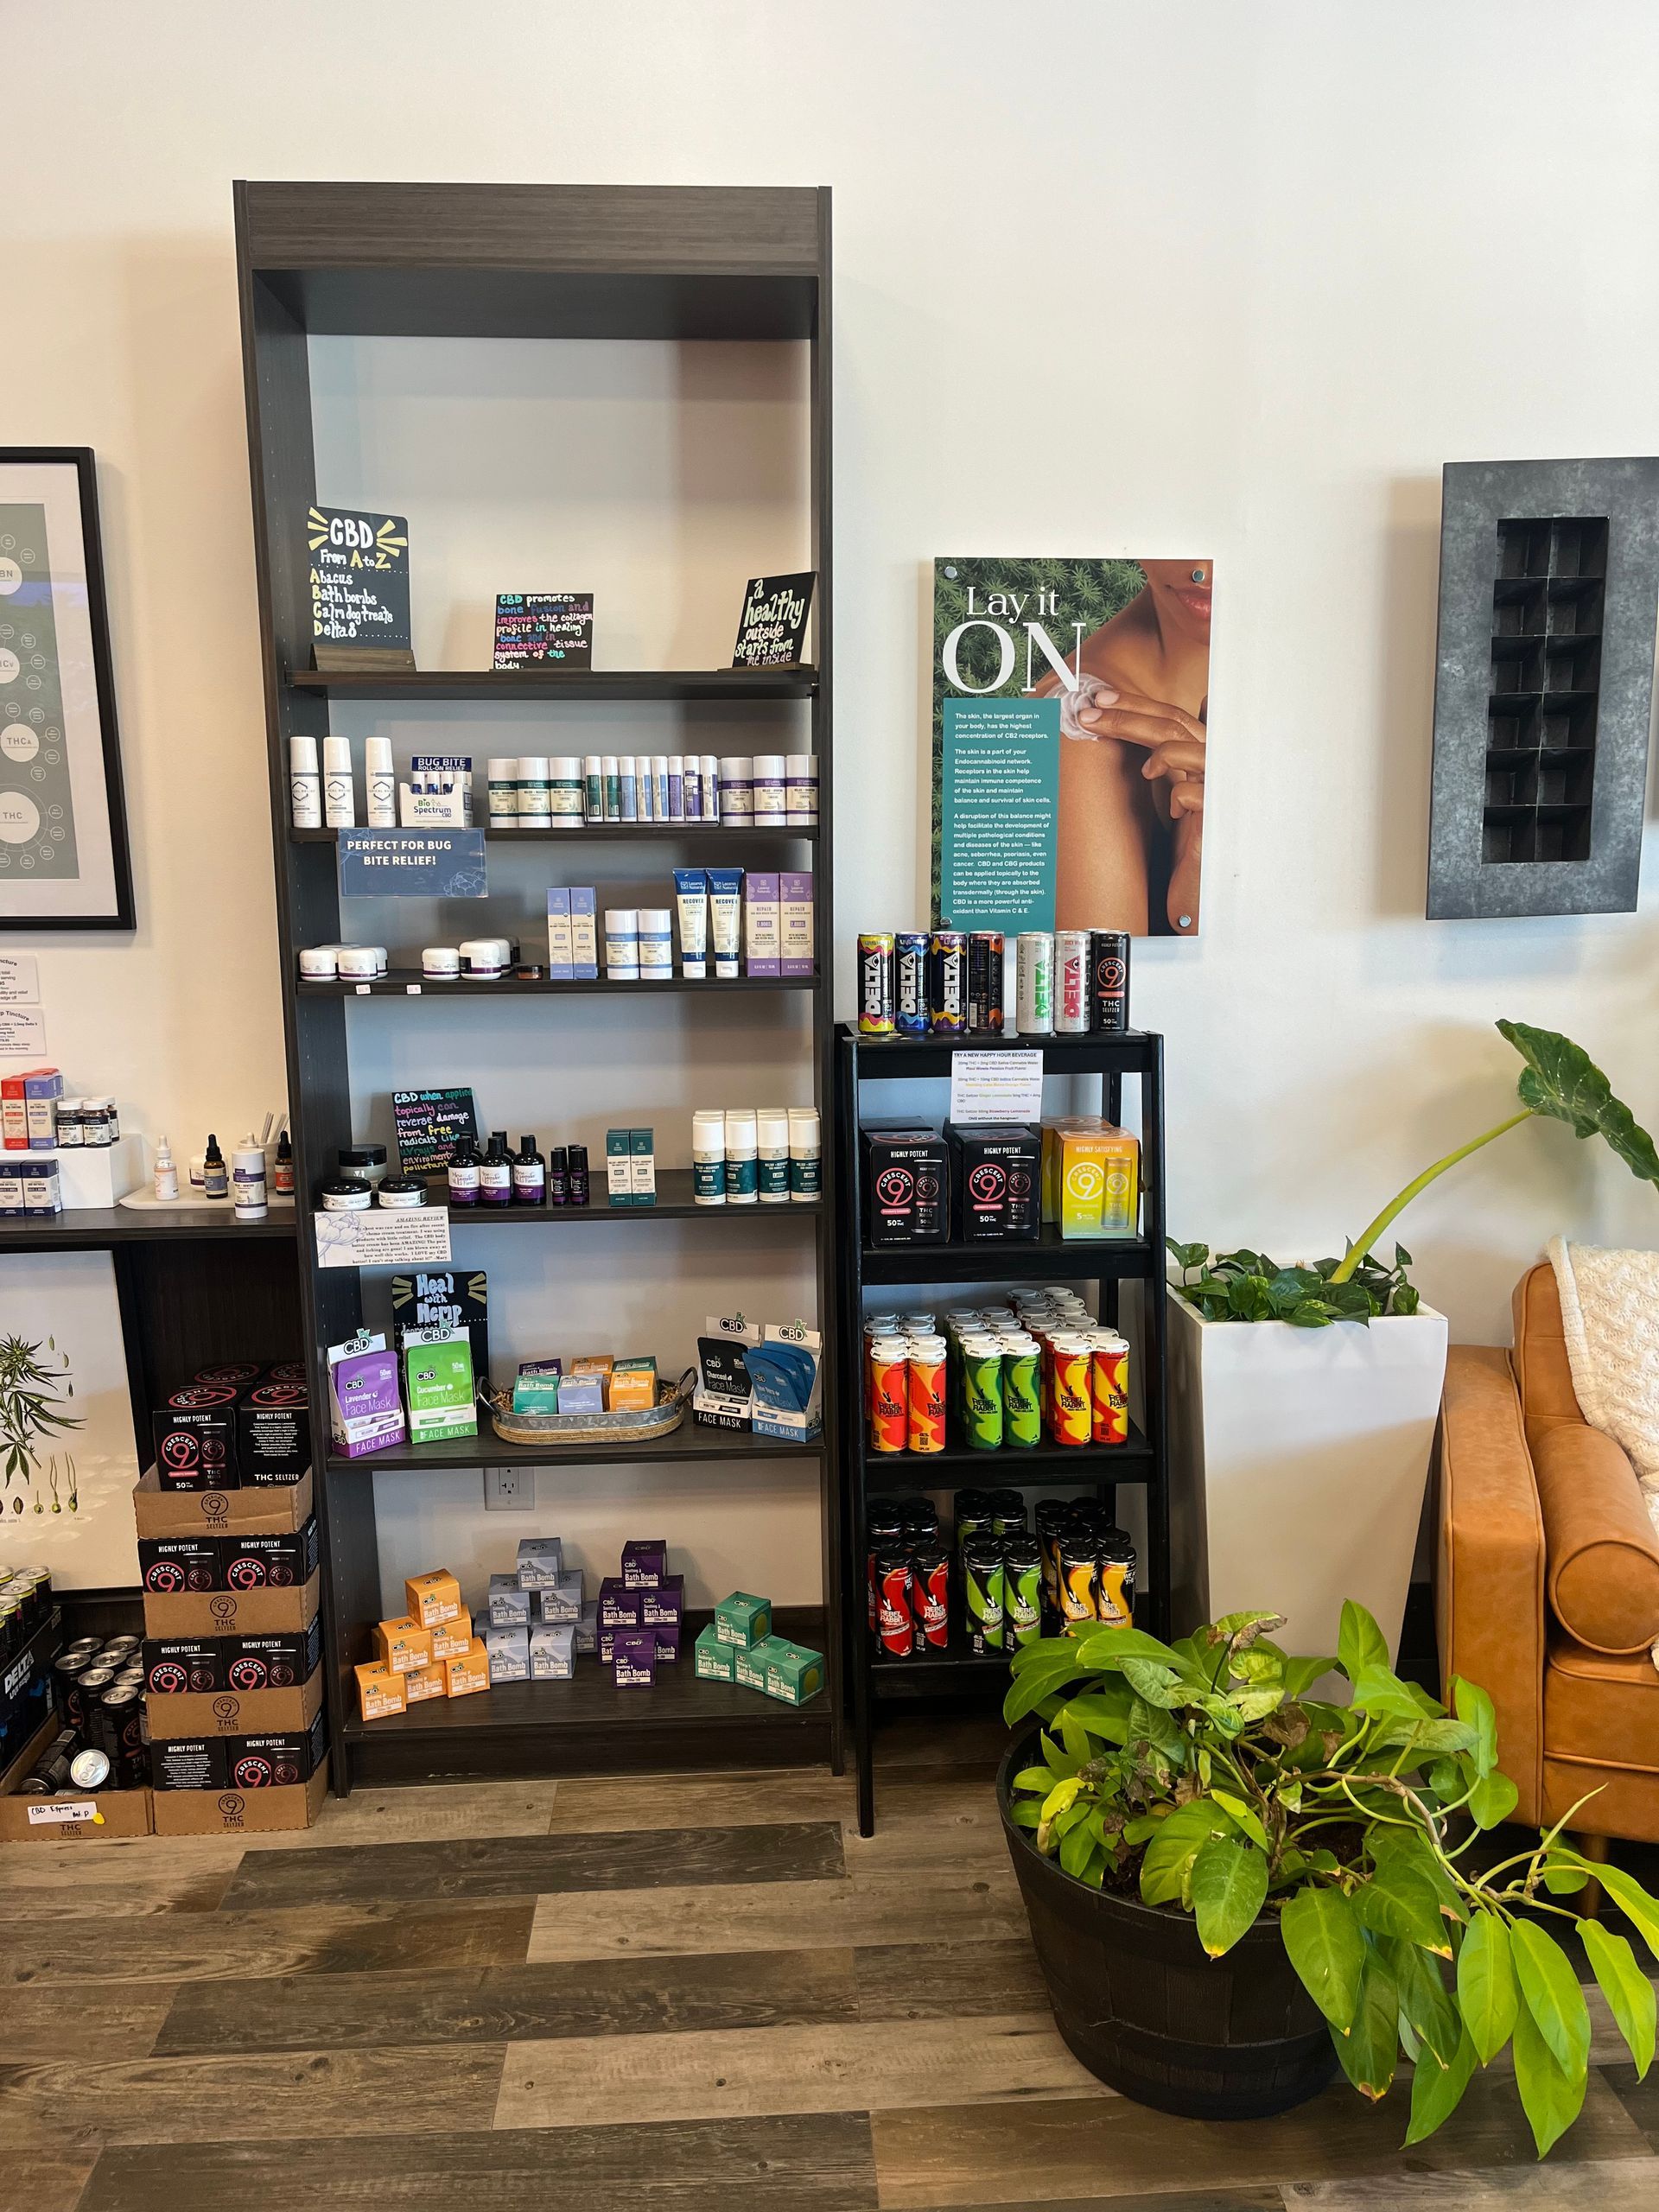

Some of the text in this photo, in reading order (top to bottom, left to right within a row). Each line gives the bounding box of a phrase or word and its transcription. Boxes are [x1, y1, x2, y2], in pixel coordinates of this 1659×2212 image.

[330, 518, 374, 548] CBD
[320, 548, 391, 569] From A to Z
[310, 568, 353, 584] Abacus
[312, 585, 377, 605] Bath bombs
[500, 594, 575, 607] CBD promotes
[497, 606, 523, 614] bone
[568, 601, 589, 611] and
[743, 589, 805, 629] healthy
[966, 586, 1060, 624] Lay it
[313, 601, 393, 625] Calm dog treats
[497, 613, 593, 626] improves the collagen
[314, 620, 357, 638] Delta 8
[496, 622, 581, 637] profile in healing
[500, 631, 556, 642] bone and in
[746, 621, 784, 640] outside
[496, 640, 588, 650] connective tissue
[735, 638, 794, 658] starts from
[495, 649, 565, 663] system of the
[762, 651, 792, 665] inside
[942, 620, 1086, 693] ON
[418, 758, 465, 766] BUG BITE
[418, 798, 430, 807] Bio
[3, 812, 23, 820] THC
[413, 806, 452, 815] Spectrum
[347, 840, 452, 850] PERFECT FOR BUG
[364, 856, 436, 865] BITE RELIEF!
[1100, 961, 1123, 973] CRESCENT
[864, 951, 881, 1015] DELTA
[899, 951, 916, 1014] DELTA
[943, 951, 960, 1014] DELTA
[1105, 966, 1118, 986] 9
[1064, 955, 1080, 1018] DELTA
[6, 1011, 29, 1021] Tincture
[394, 1093, 418, 1104] CBD
[420, 1091, 444, 1101] when
[395, 1102, 459, 1118] topically can
[396, 1112, 469, 1127] reverse damage
[397, 1128, 425, 1138] from
[399, 1135, 437, 1147] radicals
[438, 1142, 456, 1150] and
[880, 1172, 911, 1187] CRESCENT
[973, 1168, 1003, 1183] CRESCENT
[887, 1179, 904, 1204] 9
[416, 1273, 454, 1297] Heal
[424, 1294, 448, 1303] with
[416, 1303, 462, 1327] Hemp
[720, 1318, 744, 1332] CBD
[421, 1328, 450, 1342] CBD
[779, 1326, 804, 1341] CBD
[344, 1337, 370, 1355] CBD
[706, 1359, 721, 1368] CBD
[416, 1370, 436, 1381] CBD
[707, 1370, 727, 1381] Charcoal
[345, 1380, 364, 1390] CBD
[417, 1383, 446, 1393] Cucumber
[345, 1392, 372, 1404] Lavender
[417, 1390, 465, 1407] Face Mask
[345, 1398, 392, 1417] Face Mask
[698, 1412, 741, 1429] FACE MASK
[424, 1425, 470, 1438] FACE MASK
[761, 1423, 799, 1438] FACE MASK
[166, 1436, 196, 1451] CRESCENT
[356, 1430, 401, 1453] FACE MASK
[641, 1573, 658, 1581] Bomb
[424, 1604, 458, 1618] Bath Bomb
[717, 1626, 746, 1639] Bath Bomb
[5, 1650, 35, 1694] DELTA
